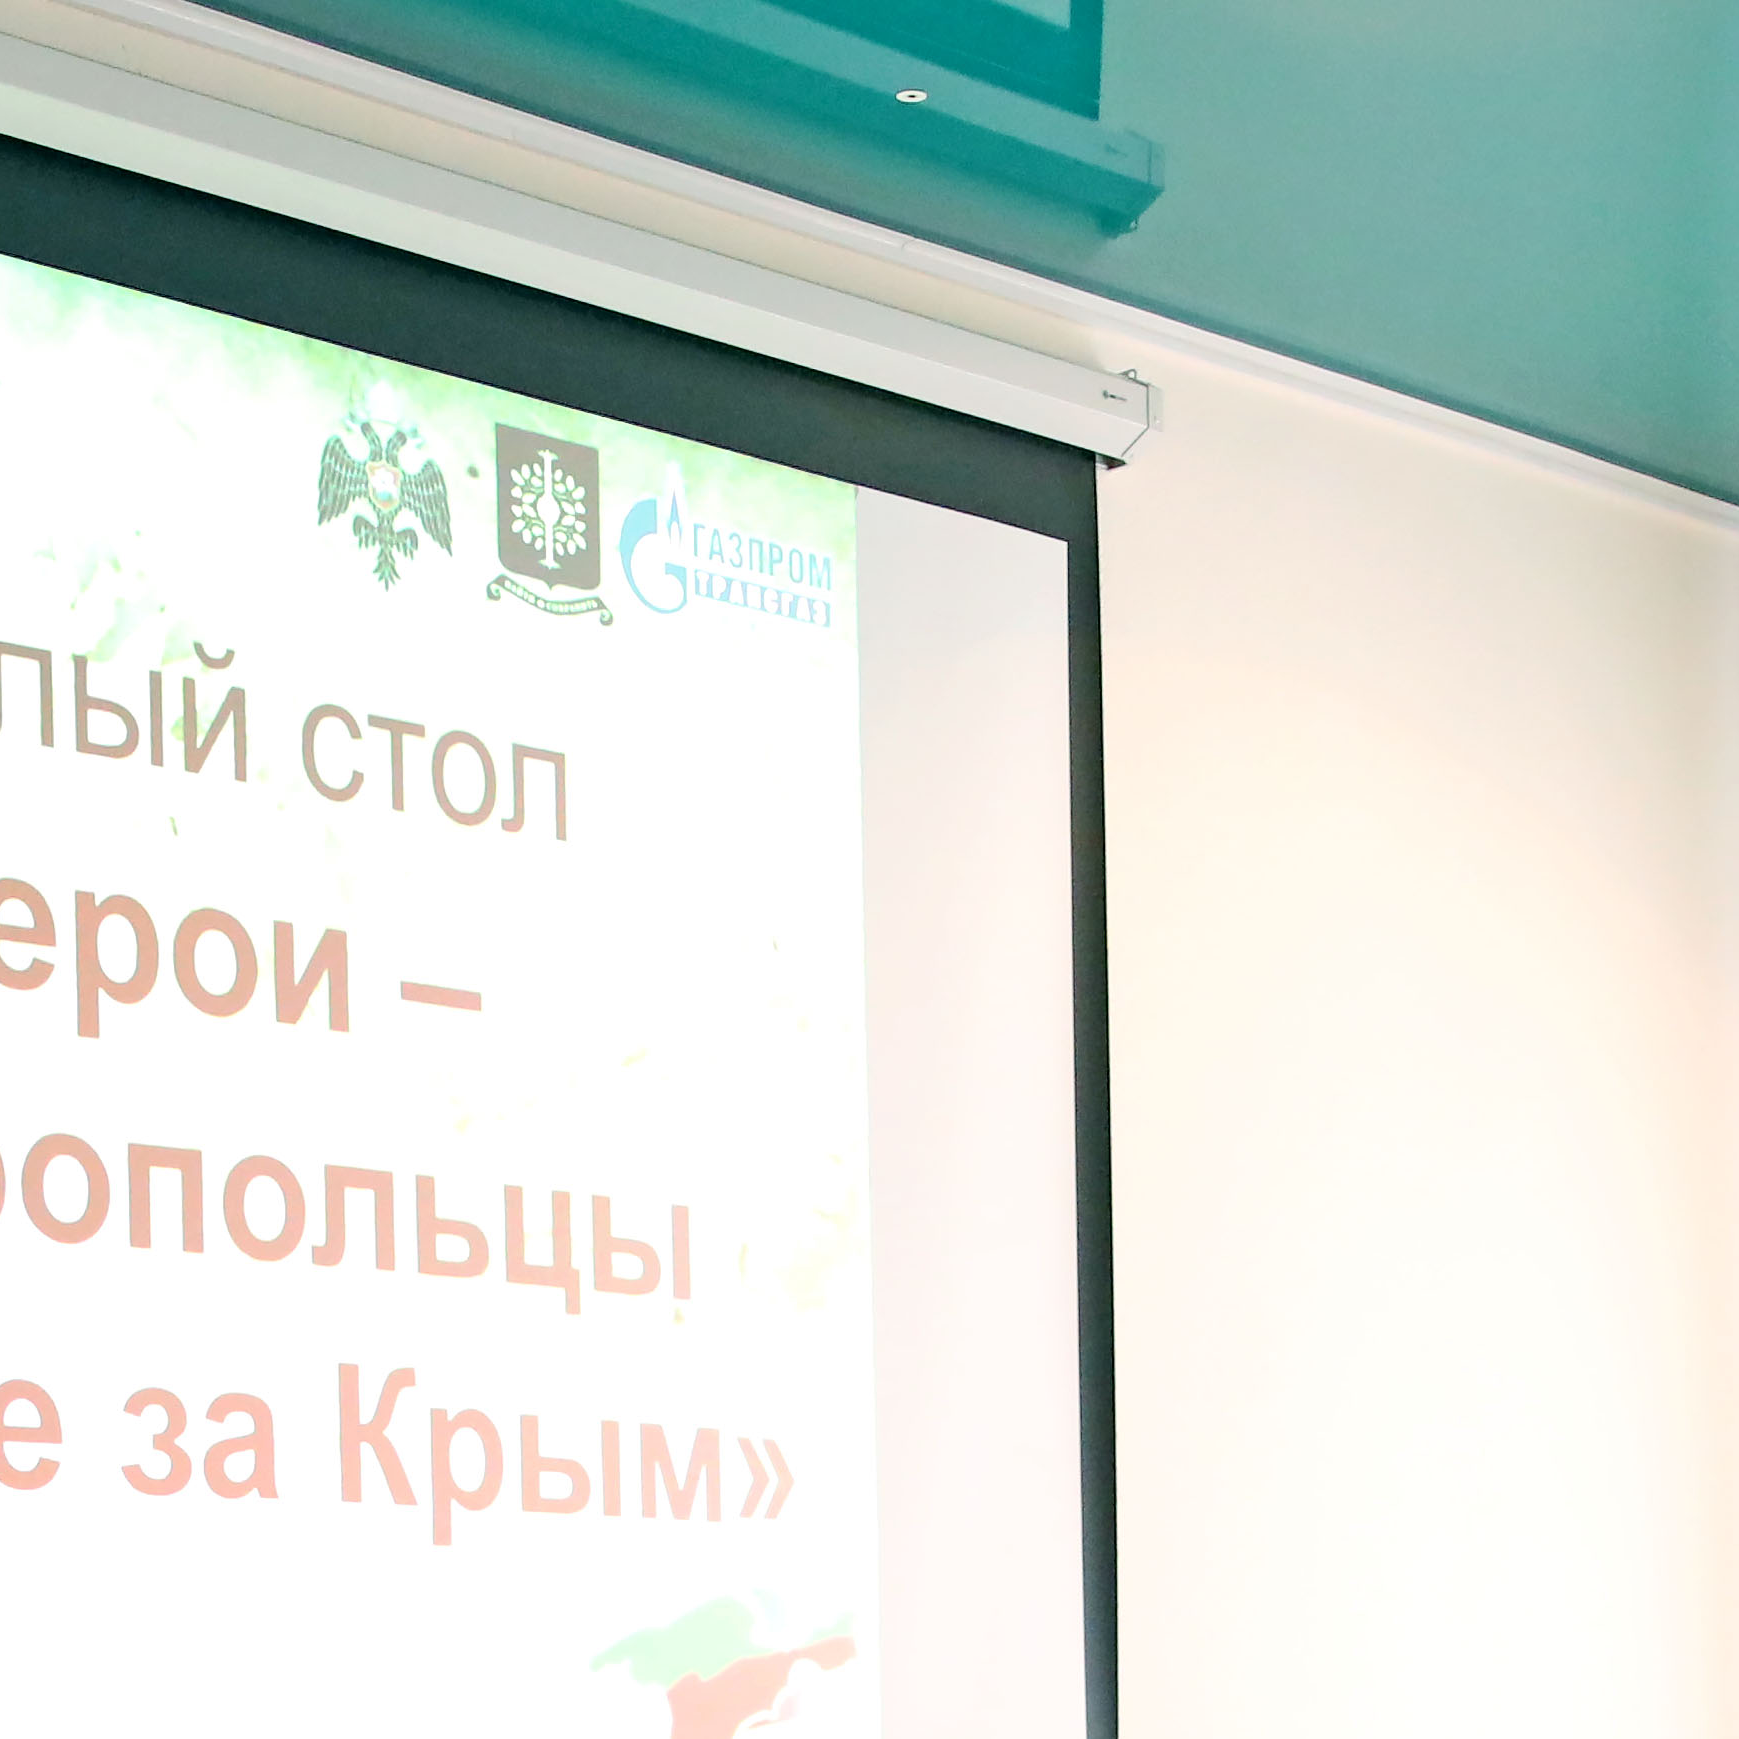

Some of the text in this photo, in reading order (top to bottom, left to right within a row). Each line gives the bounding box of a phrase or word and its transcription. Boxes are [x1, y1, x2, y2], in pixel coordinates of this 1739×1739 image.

[693, 522, 832, 591] ГАЗПРОМ
[299, 704, 568, 841] стол
[120, 1386, 280, 1500] за
[337, 1362, 795, 1547] Крым»
